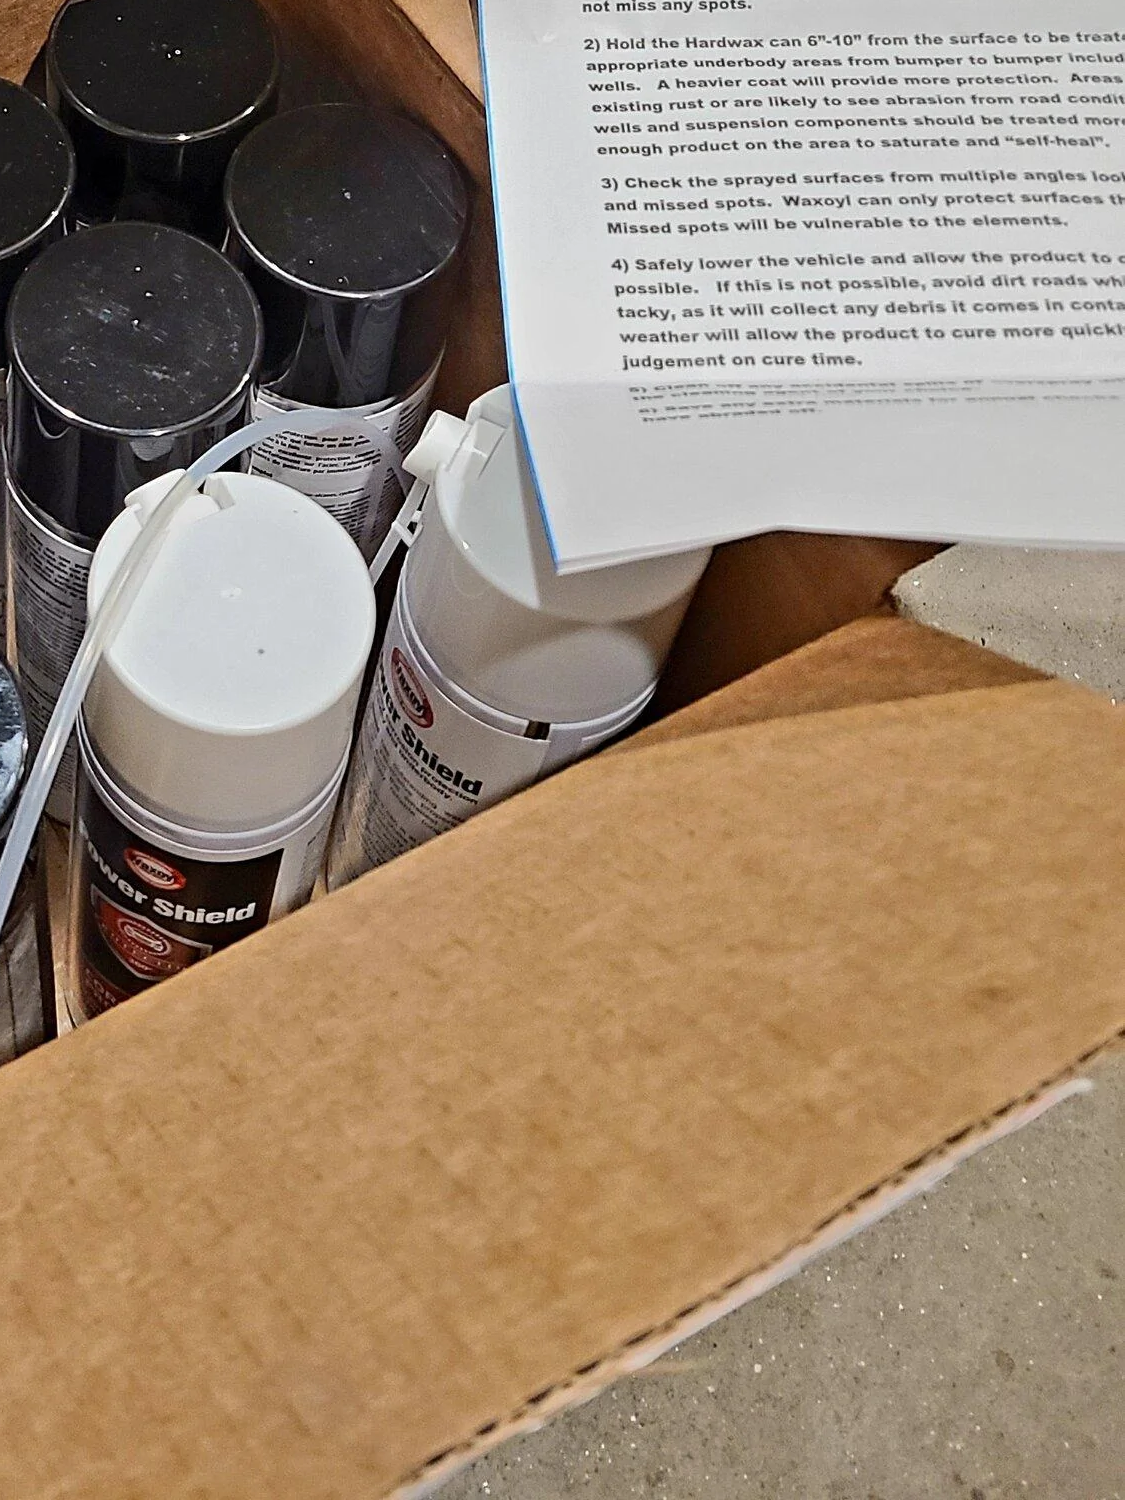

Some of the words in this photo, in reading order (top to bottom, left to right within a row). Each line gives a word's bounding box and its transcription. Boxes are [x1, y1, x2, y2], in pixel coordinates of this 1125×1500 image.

[582, 0, 611, 13] not
[661, 0, 693, 14] any
[583, 38, 601, 53] 2)
[606, 37, 646, 50] Hold
[651, 37, 680, 49] the
[685, 36, 764, 49] Hardwax
[769, 38, 802, 48] can
[867, 34, 909, 46] from
[914, 33, 943, 46] the
[949, 32, 1017, 45] surface
[1023, 32, 1042, 44] to
[1048, 31, 1070, 43] be
[586, 58, 689, 74] appropriate
[693, 57, 787, 70] underbody
[792, 58, 843, 67] areas
[847, 56, 890, 67] from
[894, 56, 963, 68] bumper
[968, 55, 988, 65] to
[993, 54, 1063, 66] bumper
[588, 80, 641, 92] wells.
[657, 79, 671, 91] A
[675, 76, 742, 89] heavier
[747, 76, 788, 87] coat
[792, 76, 825, 87] will
[831, 75, 899, 89] provide
[903, 76, 950, 85] more
[956, 74, 1058, 88] protection.
[1070, 72, 1124, 84] Areas
[591, 100, 663, 114] existing
[668, 98, 705, 111] rust
[709, 99, 728, 108] or
[733, 98, 763, 108] are
[767, 96, 817, 109] likely
[823, 96, 842, 106] to
[847, 97, 880, 106] see
[885, 94, 966, 106] abrasion
[970, 94, 1014, 105] from
[1019, 93, 1061, 104] road
[593, 122, 642, 134] wells
[647, 120, 680, 133] and
[685, 117, 789, 132] suspension
[794, 116, 908, 130] components
[913, 114, 975, 126] should
[980, 115, 1004, 126] be
[1009, 114, 1079, 125] treated
[597, 143, 663, 157] enough
[668, 140, 740, 157] product
[745, 141, 767, 151] on
[772, 138, 803, 150] the
[809, 139, 851, 149] area
[855, 138, 875, 148] to
[881, 137, 960, 148] saturate
[965, 136, 1000, 147] and
[601, 177, 619, 192] 3)
[624, 176, 683, 189] Check
[687, 176, 718, 188] the
[723, 173, 797, 189] sprayed
[803, 172, 885, 184] surfaces
[889, 171, 934, 183] from
[939, 169, 1017, 184] multiple
[1024, 169, 1087, 183] angles
[604, 199, 638, 212] and
[643, 198, 709, 212] missed
[715, 196, 773, 212] spots.
[781, 194, 851, 209] Waxoyl
[857, 196, 893, 206] can
[898, 193, 938, 208] only
[944, 192, 1015, 207] protect
[1021, 191, 1104, 205] surfaces
[607, 222, 672, 234] Missed
[677, 220, 729, 236] spots
[733, 218, 769, 231] will
[773, 218, 797, 230] be
[801, 216, 903, 230] vulnerable
[908, 217, 929, 228] to
[934, 215, 966, 227] the
[972, 214, 1068, 227] elements.
[611, 258, 629, 274] 4)
[635, 258, 694, 273] Safely
[699, 257, 753, 270] lower
[757, 255, 790, 267] the
[794, 253, 865, 266] vehicle
[871, 252, 907, 265] and
[913, 252, 965, 264] allow
[971, 251, 1003, 263] the
[1009, 251, 1086, 266] product
[1091, 252, 1112, 264] to
[614, 282, 699, 298] possible.
[716, 280, 730, 293] If
[735, 279, 773, 292] this
[777, 278, 795, 291] is
[801, 278, 833, 291] not
[838, 276, 927, 293] possible,
[932, 275, 985, 288] avoid
[991, 275, 1026, 287] dirt
[1032, 274, 1088, 287] roads
[622, 353, 726, 371] judgement
[731, 355, 756, 366] on
[761, 355, 806, 366] cure
[811, 352, 863, 366] time.
[401, 722, 483, 796] Shield
[152, 898, 257, 925] Shield
